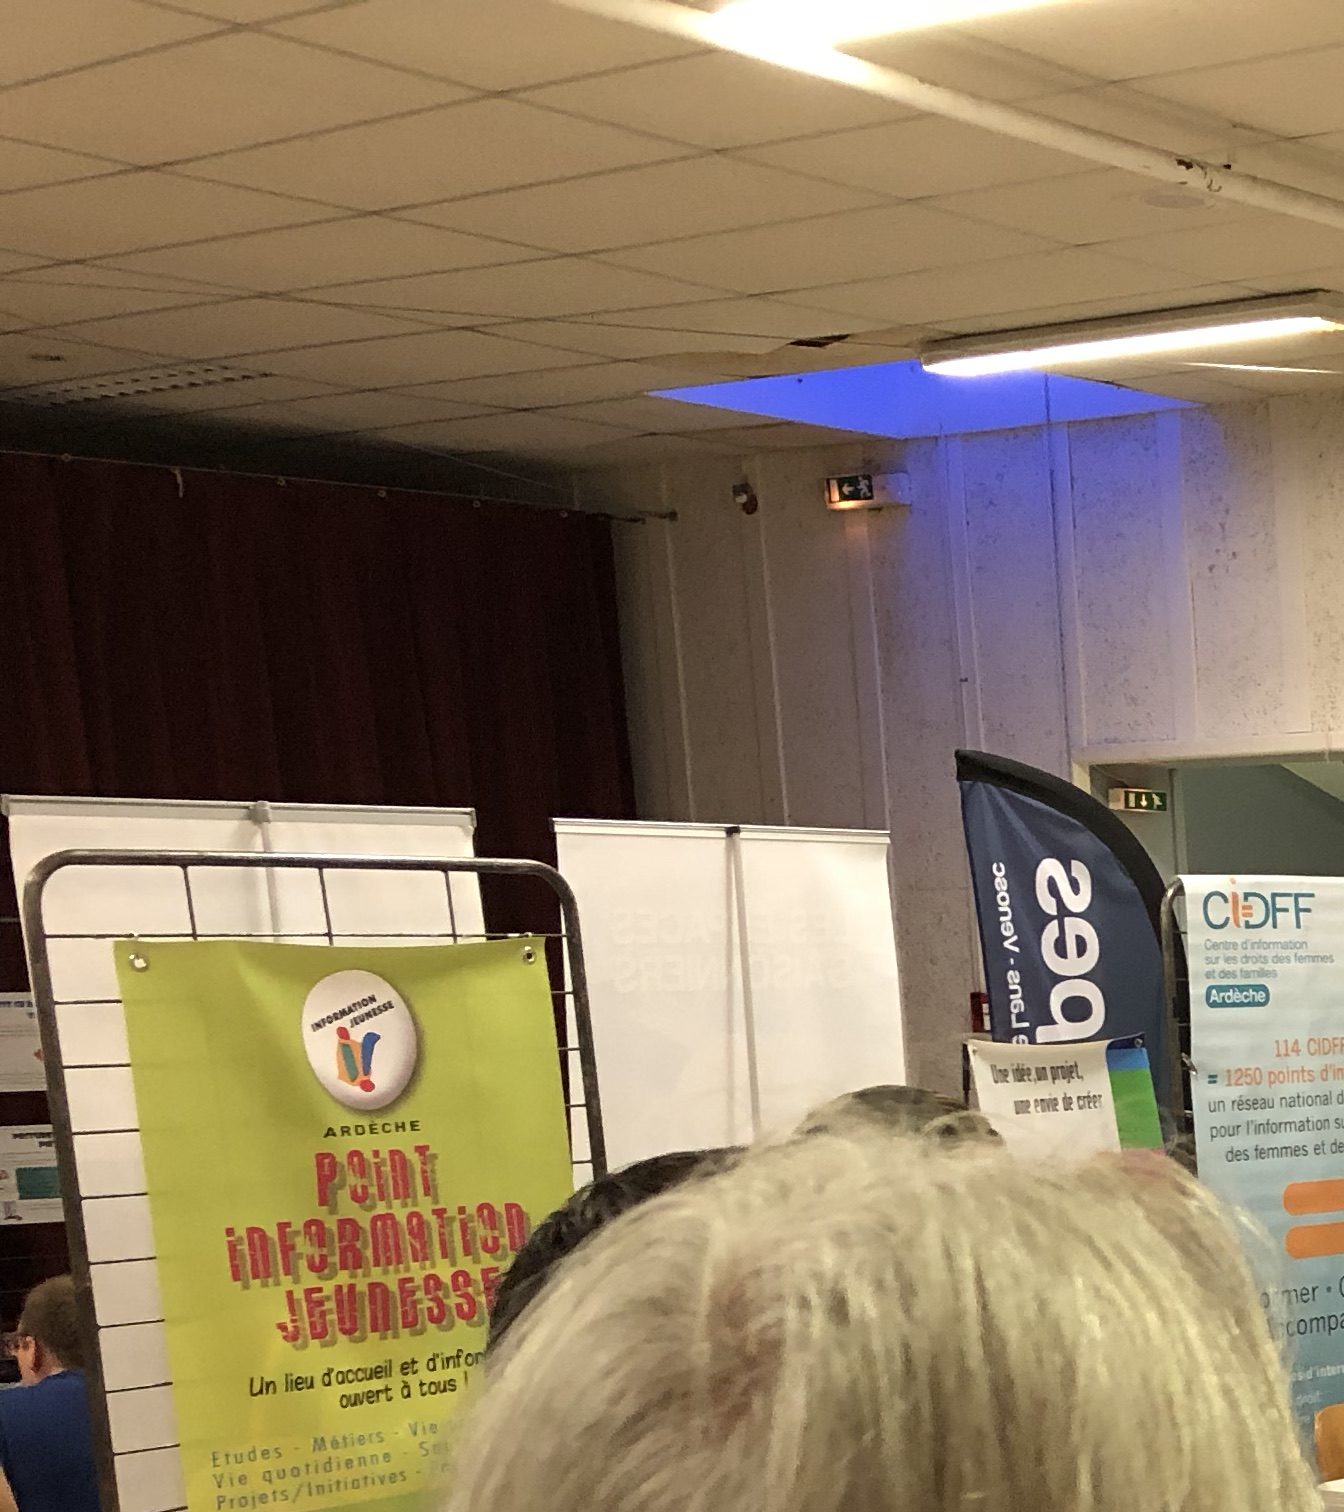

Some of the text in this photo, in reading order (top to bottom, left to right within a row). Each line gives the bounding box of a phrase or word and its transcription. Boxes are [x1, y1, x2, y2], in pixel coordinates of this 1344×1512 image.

[1204, 939, 1308, 951] Centre d'information
[1205, 952, 1335, 965] sur les droits des femmes
[1205, 967, 1278, 979] et des familles
[1208, 988, 1267, 1004] Ardèche
[310, 994, 377, 1032] INFORMATION
[349, 1000, 395, 1028] JEUNESSE
[1274, 1039, 1301, 1057] 114
[1225, 1067, 1263, 1087] 1250
[1267, 1066, 1316, 1088] points
[1208, 1099, 1226, 1113] un
[1231, 1094, 1275, 1112] réseau
[1279, 1091, 1333, 1109] national
[322, 1119, 422, 1138] ARDÈCHE
[1209, 1122, 1242, 1141] pour
[1246, 1117, 1331, 1137] l'information
[1225, 1146, 1250, 1163] des
[1254, 1141, 1309, 1160] femmes
[1313, 1140, 1326, 1156] et
[249, 1376, 277, 1398] Un
[284, 1372, 315, 1393] lieu
[321, 1358, 393, 1388] d'accueil
[400, 1354, 418, 1377] et
[339, 1384, 394, 1409] ouvert
[400, 1380, 412, 1400] à
[419, 1376, 458, 1396] tous
[211, 1446, 283, 1468] Etudes
[311, 1429, 385, 1453] Métiers
[408, 1420, 439, 1437] Vie
[212, 1472, 248, 1489] Vie
[262, 1449, 393, 1485] quotidienne
[216, 1470, 408, 1511] Projets/Initiatives
